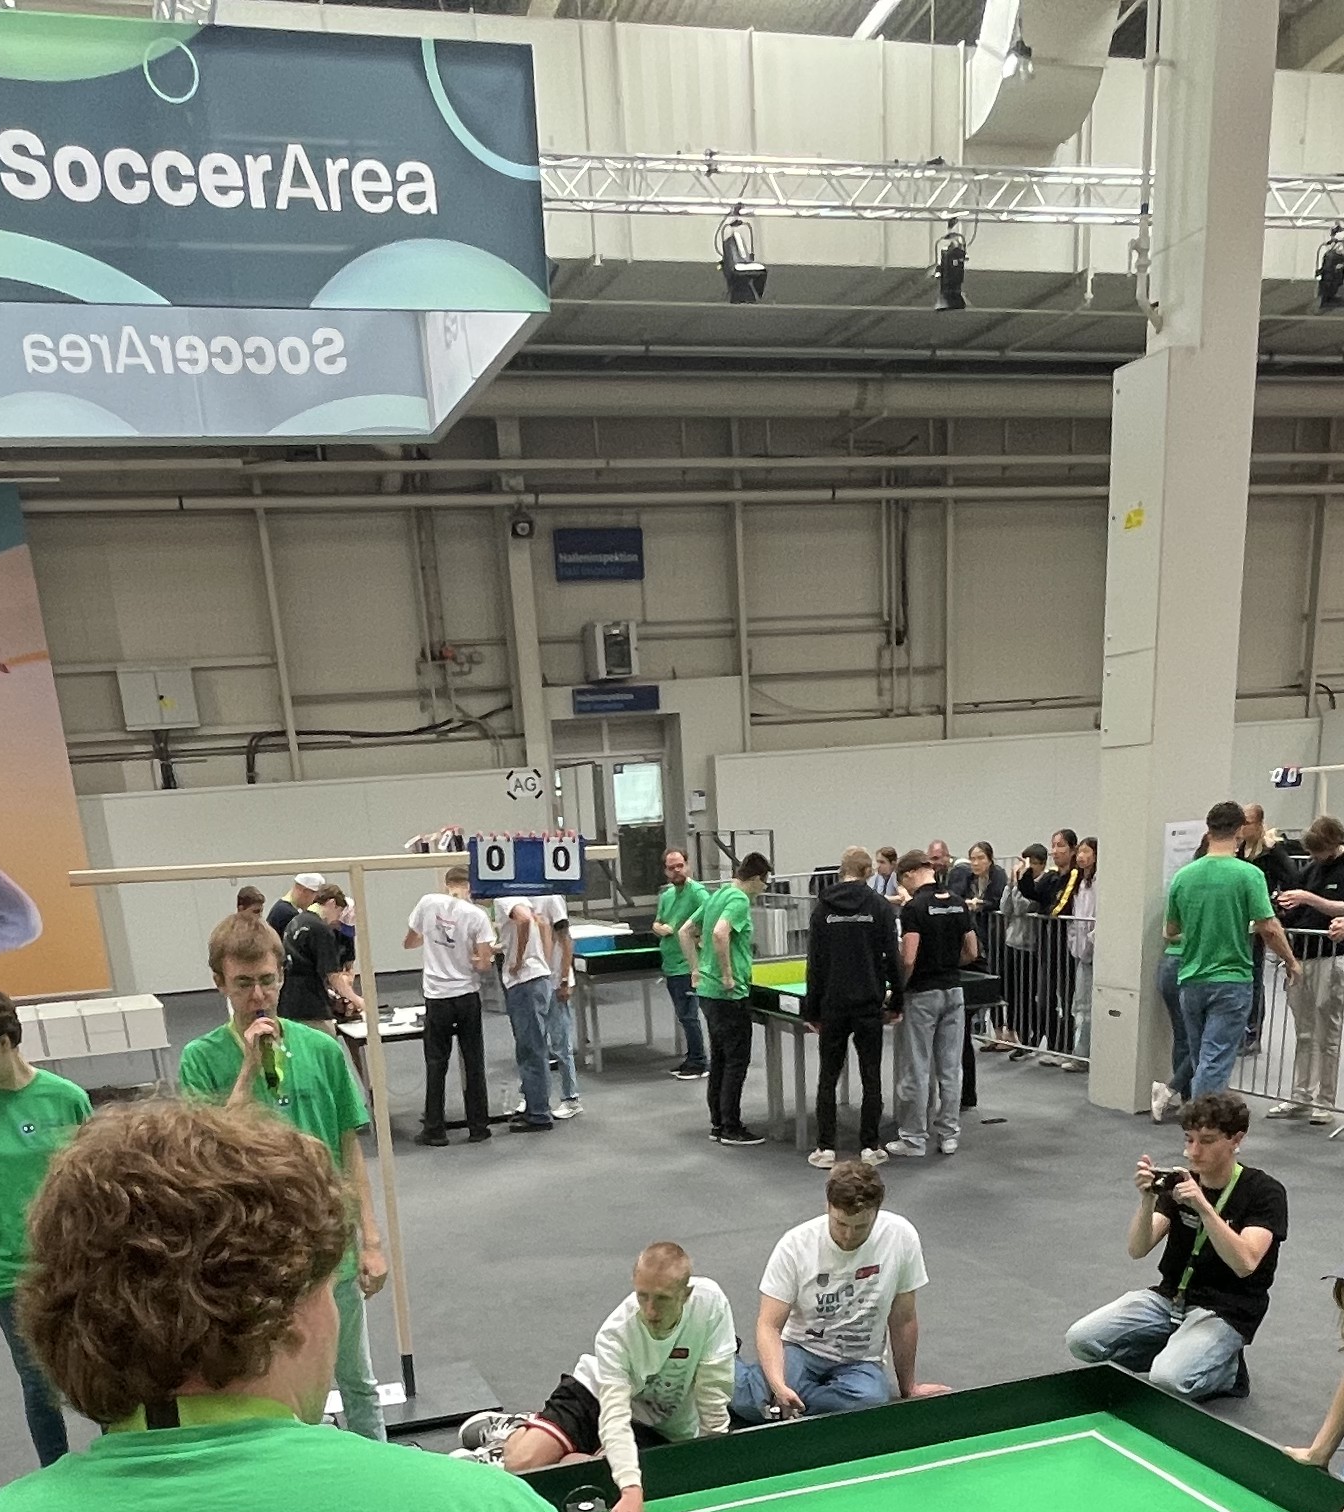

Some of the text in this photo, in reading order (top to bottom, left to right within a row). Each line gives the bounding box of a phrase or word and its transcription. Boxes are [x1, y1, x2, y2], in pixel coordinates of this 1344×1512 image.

[513, 777, 537, 793] AG
[486, 845, 570, 872] 0 0
